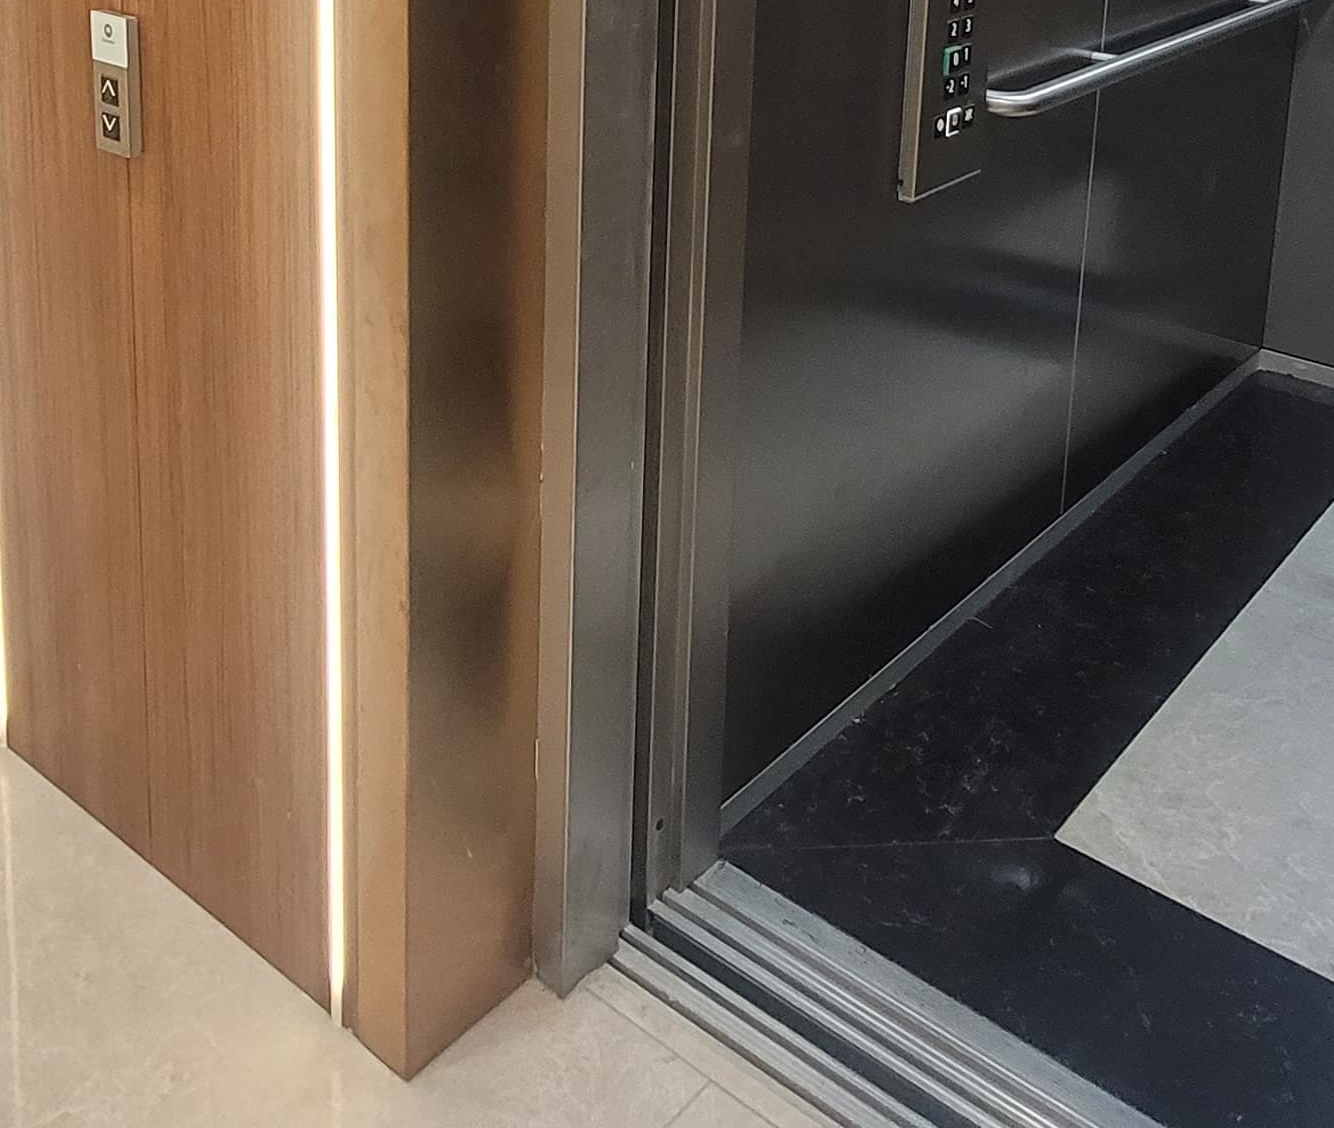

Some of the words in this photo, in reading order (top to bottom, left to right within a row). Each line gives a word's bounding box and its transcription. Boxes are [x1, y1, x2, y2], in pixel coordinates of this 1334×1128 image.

[951, 22, 957, 37] 2
[965, 18, 972, 33] 3
[953, 52, 959, 66] 0
[964, 47, 969, 61] 1
[946, 79, 955, 94] -2
[960, 75, 968, 89] -1
